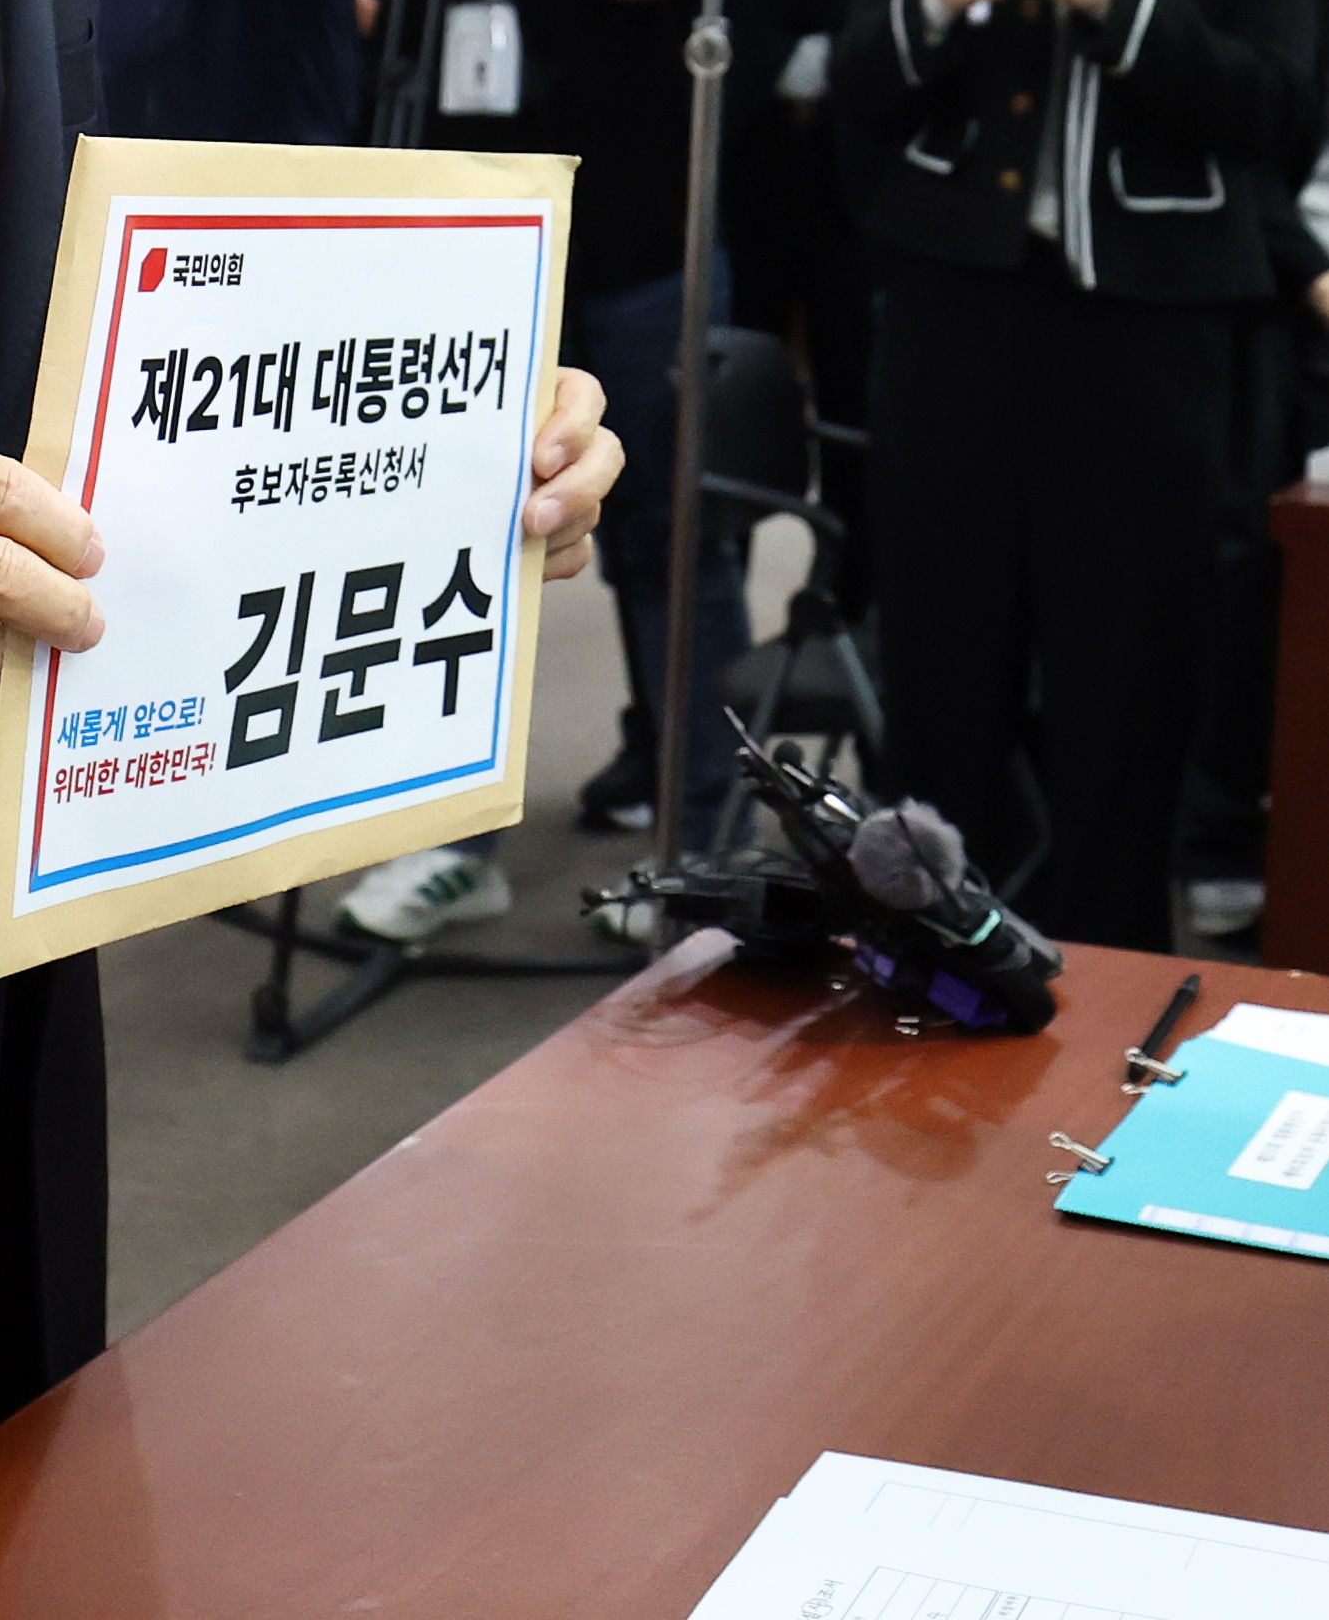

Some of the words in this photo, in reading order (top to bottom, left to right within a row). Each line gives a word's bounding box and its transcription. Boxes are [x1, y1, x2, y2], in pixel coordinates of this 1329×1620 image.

[172, 253, 244, 287] 국민의힘
[131, 341, 301, 444] 제21대
[311, 328, 510, 427] 대통령선거
[230, 442, 428, 514] 후보자등록신청서
[223, 546, 494, 771] 김문수
[56, 705, 128, 750] 새롭게
[133, 696, 206, 740] 앞으로!
[53, 757, 120, 805] 위대한
[124, 742, 217, 789] 대한민국!
